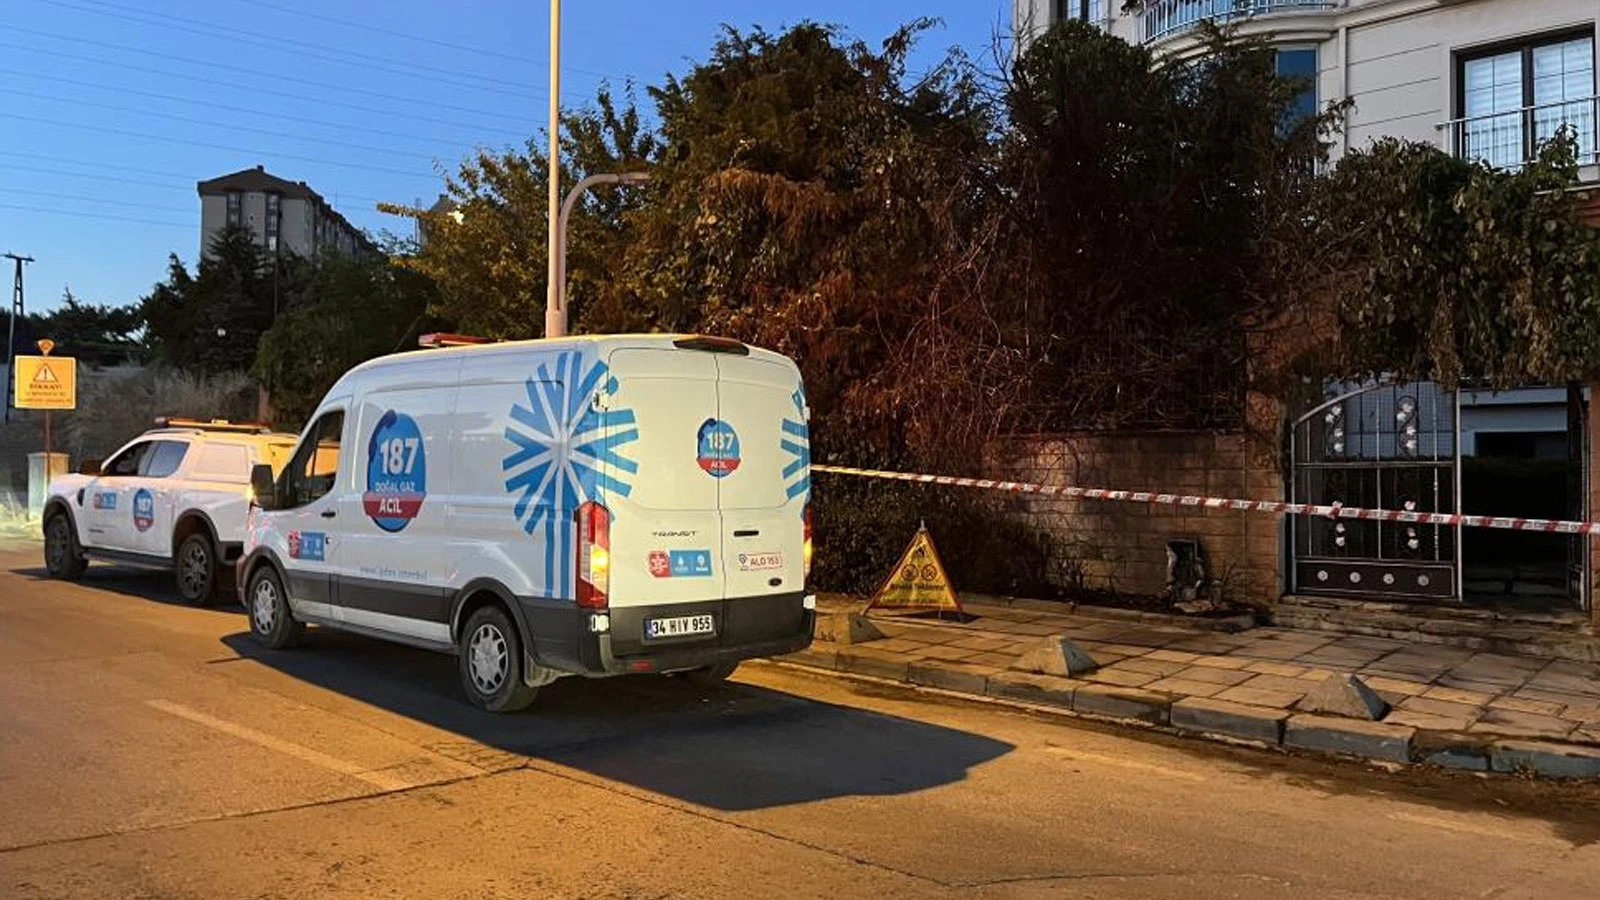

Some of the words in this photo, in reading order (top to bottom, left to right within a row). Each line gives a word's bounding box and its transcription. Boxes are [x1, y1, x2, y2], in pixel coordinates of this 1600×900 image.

[707, 432, 735, 450] 187
[380, 438, 419, 475] 187
[652, 620, 666, 634] 34
